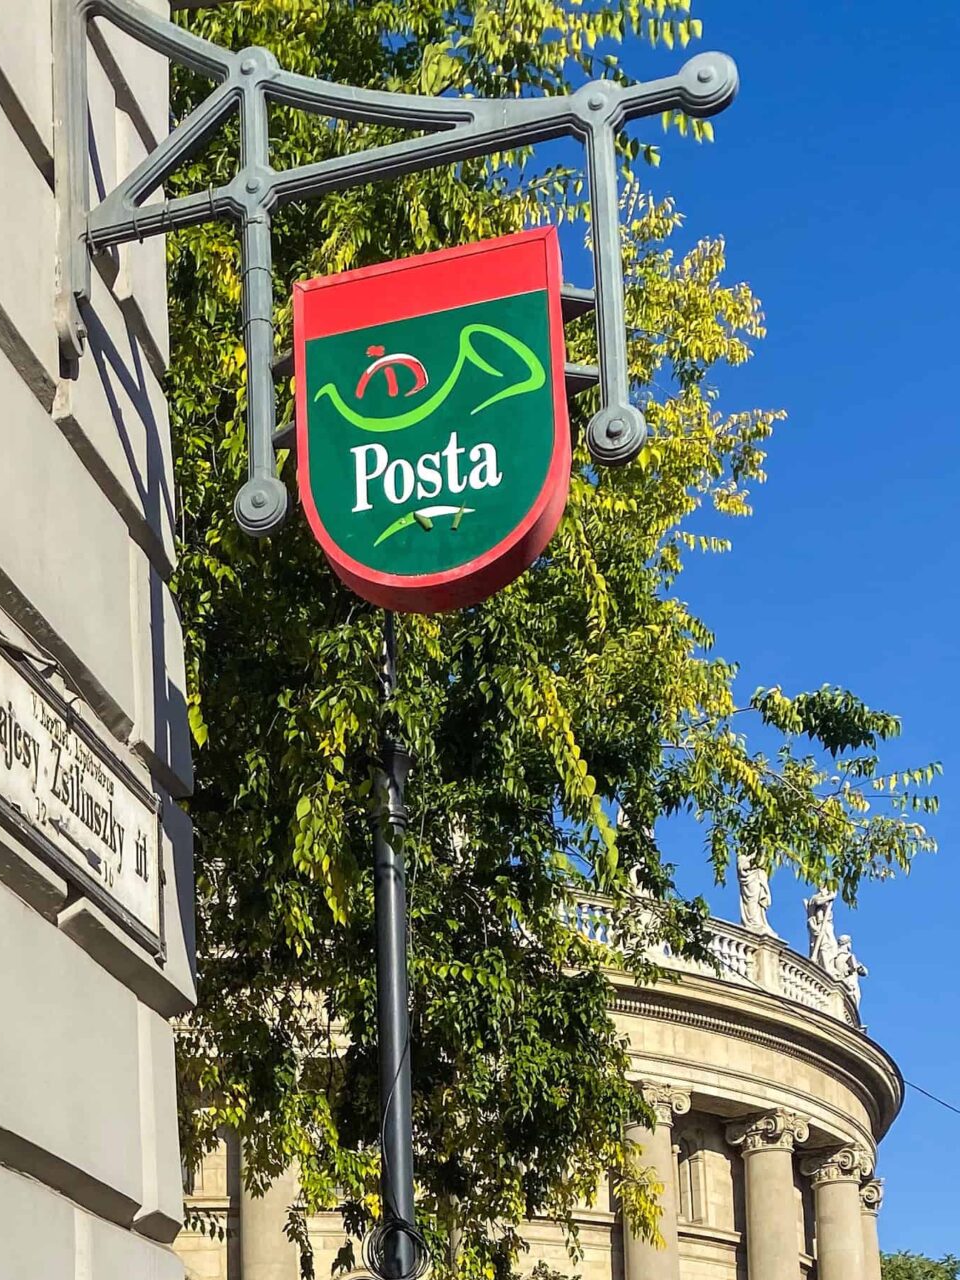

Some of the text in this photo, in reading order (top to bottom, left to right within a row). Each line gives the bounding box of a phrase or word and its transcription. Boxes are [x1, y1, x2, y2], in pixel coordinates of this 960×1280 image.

[350, 432, 503, 513] Posta
[35, 796, 114, 888] 12 16
